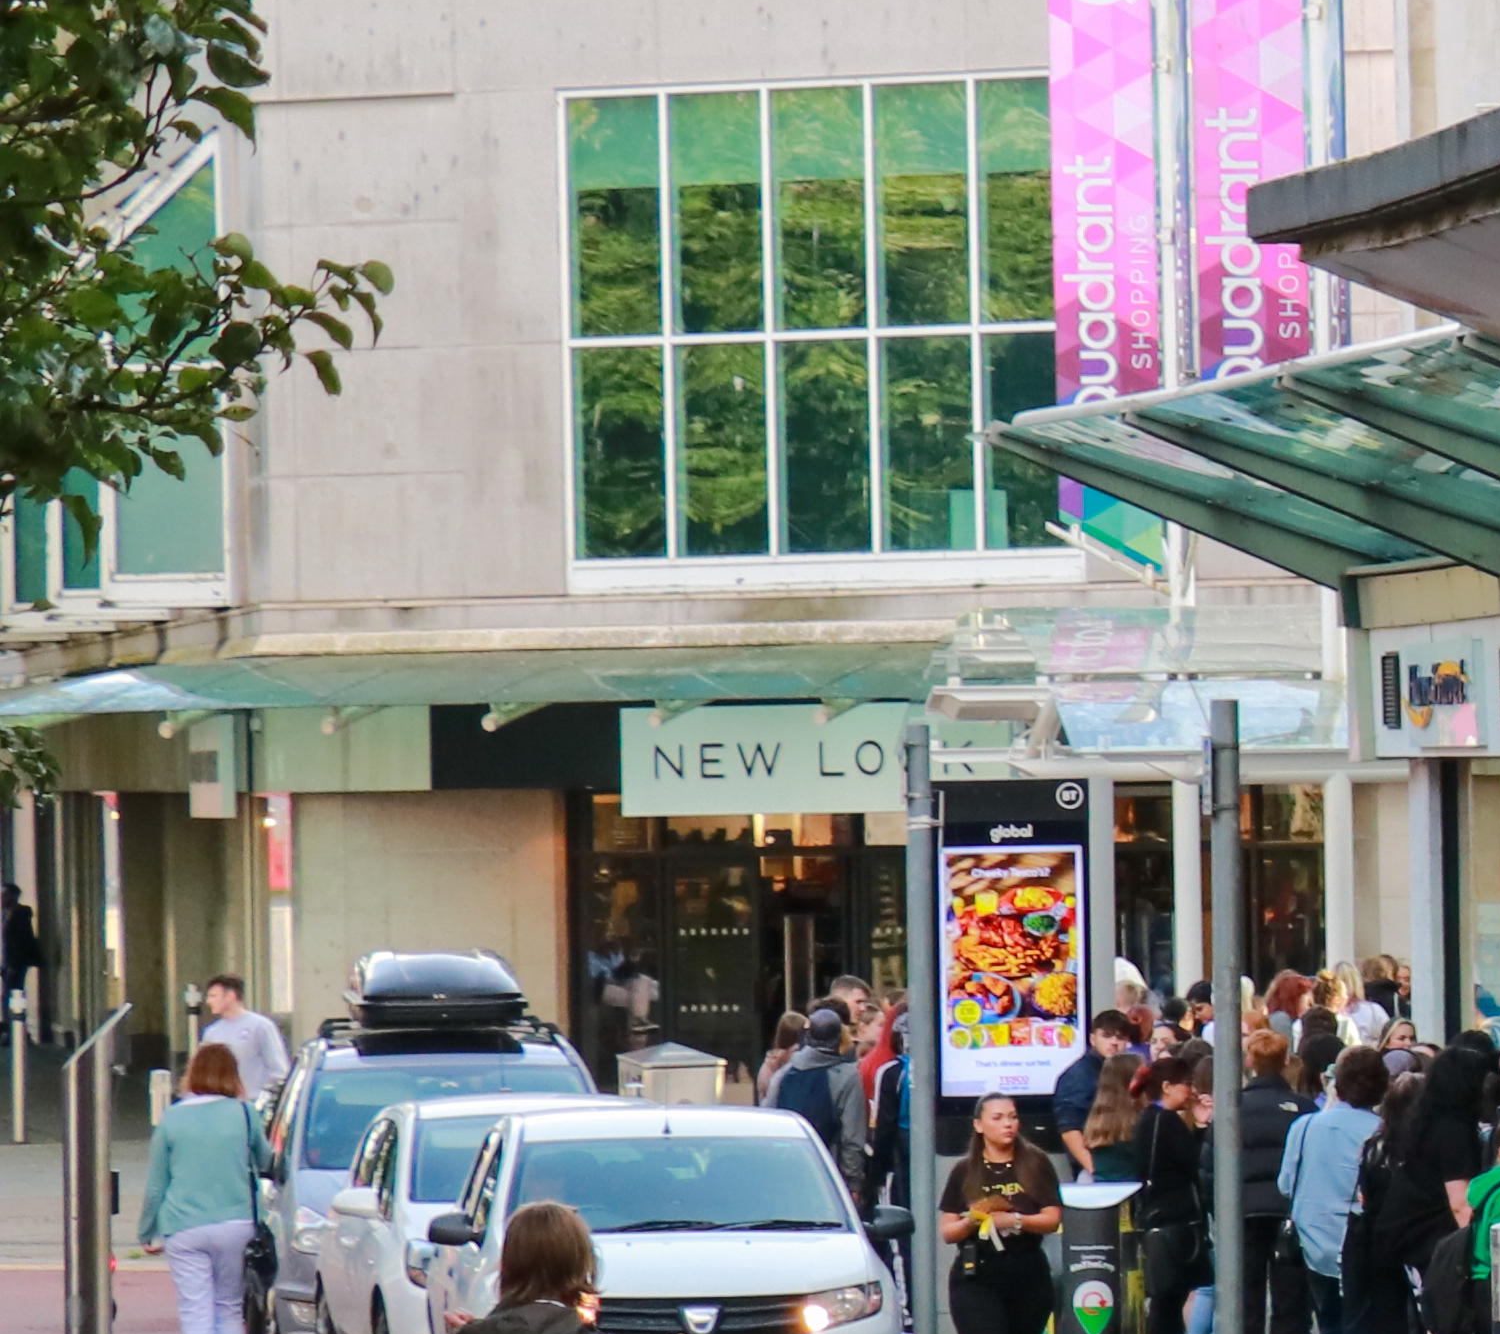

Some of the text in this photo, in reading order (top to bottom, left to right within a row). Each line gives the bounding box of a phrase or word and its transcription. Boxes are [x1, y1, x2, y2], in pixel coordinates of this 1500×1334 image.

[1131, 213, 1153, 370] SHOPPING
[1278, 250, 1301, 339] SHOP
[654, 739, 974, 779] NEW LOK
[1062, 789, 1078, 802] BT
[989, 824, 1034, 843] global
